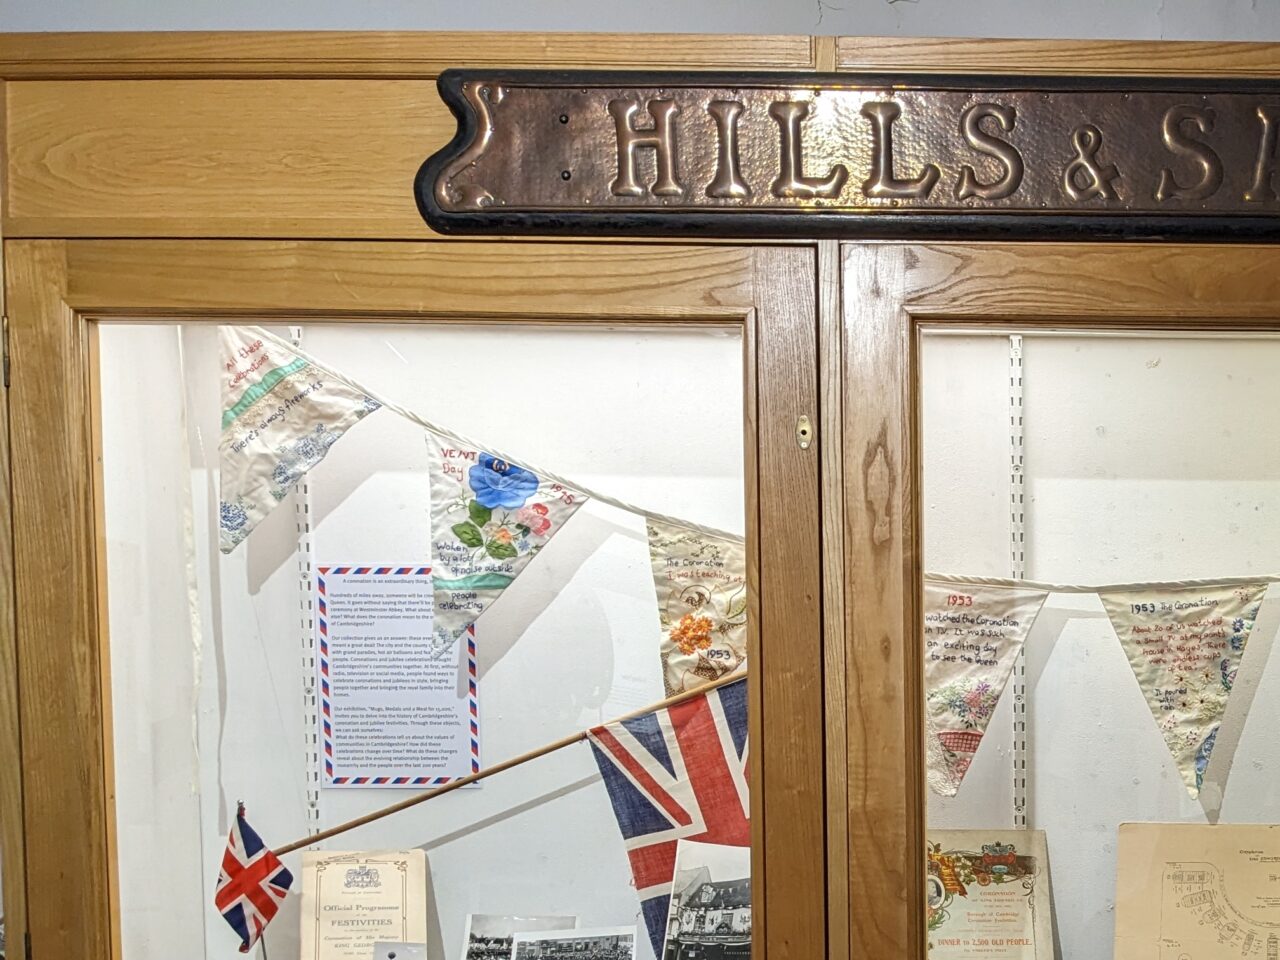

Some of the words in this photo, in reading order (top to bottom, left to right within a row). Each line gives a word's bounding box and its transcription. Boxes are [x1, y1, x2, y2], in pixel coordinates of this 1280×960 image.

[606, 100, 1025, 201] HILLS
[1063, 123, 1124, 201] &
[226, 357, 238, 371] All
[239, 340, 264, 359] these
[260, 406, 286, 430] always
[284, 380, 324, 411] fireworks
[442, 463, 463, 482] Day
[435, 541, 468, 552] Woken
[439, 553, 450, 566] by
[664, 557, 679, 567] The
[682, 558, 724, 568] Coronation
[451, 565, 460, 577] of
[461, 566, 482, 574] noise
[485, 563, 513, 573] outside
[695, 569, 731, 584] teaching
[451, 592, 477, 601] people
[947, 595, 973, 607] 1953
[1130, 603, 1156, 614] 1953
[1160, 602, 1173, 611] The
[1174, 596, 1219, 610] Coronation
[926, 613, 961, 624] watched
[961, 613, 975, 624] the
[976, 614, 1020, 627] Coronation
[1187, 616, 1223, 628] watched
[968, 629, 985, 637] was
[988, 628, 1005, 638] such
[706, 649, 731, 660] 1953
[944, 639, 980, 656] exciting
[983, 642, 998, 657] day
[931, 651, 940, 661] to
[941, 654, 957, 663] see
[960, 654, 972, 663] the
[975, 655, 998, 666] Queen
[323, 904, 353, 912] Official
[355, 904, 400, 913] Programme
[331, 918, 393, 927] FESTIVITIES
[938, 938, 961, 946] DINNER
[991, 938, 1005, 946] OLD
